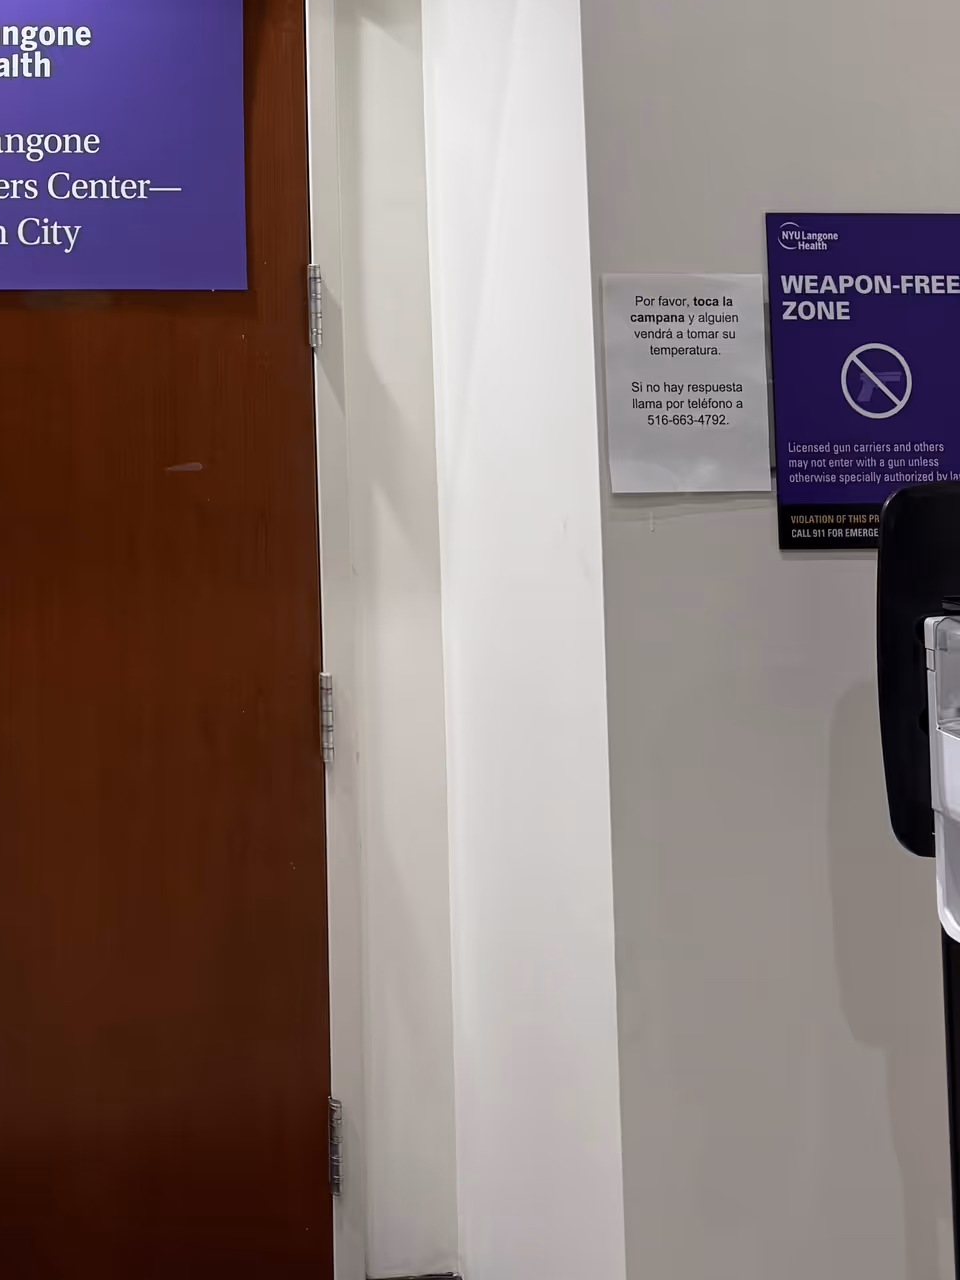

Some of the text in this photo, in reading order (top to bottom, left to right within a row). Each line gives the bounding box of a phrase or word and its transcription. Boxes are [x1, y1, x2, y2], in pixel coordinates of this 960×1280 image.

[17, 217, 82, 253] City
[781, 230, 839, 242] NYU Langone
[798, 240, 827, 250] Health
[781, 275, 960, 294] WEAPON-FREE
[635, 295, 733, 308] Por favor, toca la
[782, 301, 850, 320] ZONE
[630, 312, 739, 325] campana y alguien
[634, 328, 736, 339] vendrá a tomar su
[650, 344, 722, 358] temperatura.
[631, 382, 743, 396] Si no hay respuesta
[632, 398, 743, 412] llama por teléfono a
[647, 414, 730, 426] 516-663-4792.
[788, 441, 944, 454] Licensed gun carriers and others
[788, 456, 939, 469] may not enter with a gun unless
[789, 472, 837, 483] otherwise
[839, 472, 882, 484] specially
[884, 471, 934, 483] authorized
[949, 471, 960, 481] la
[791, 515, 834, 524] VIOLATION
[836, 514, 847, 524] OF
[848, 514, 867, 523] THIS
[791, 527, 879, 538] CALL 911 FOR EMERGE
